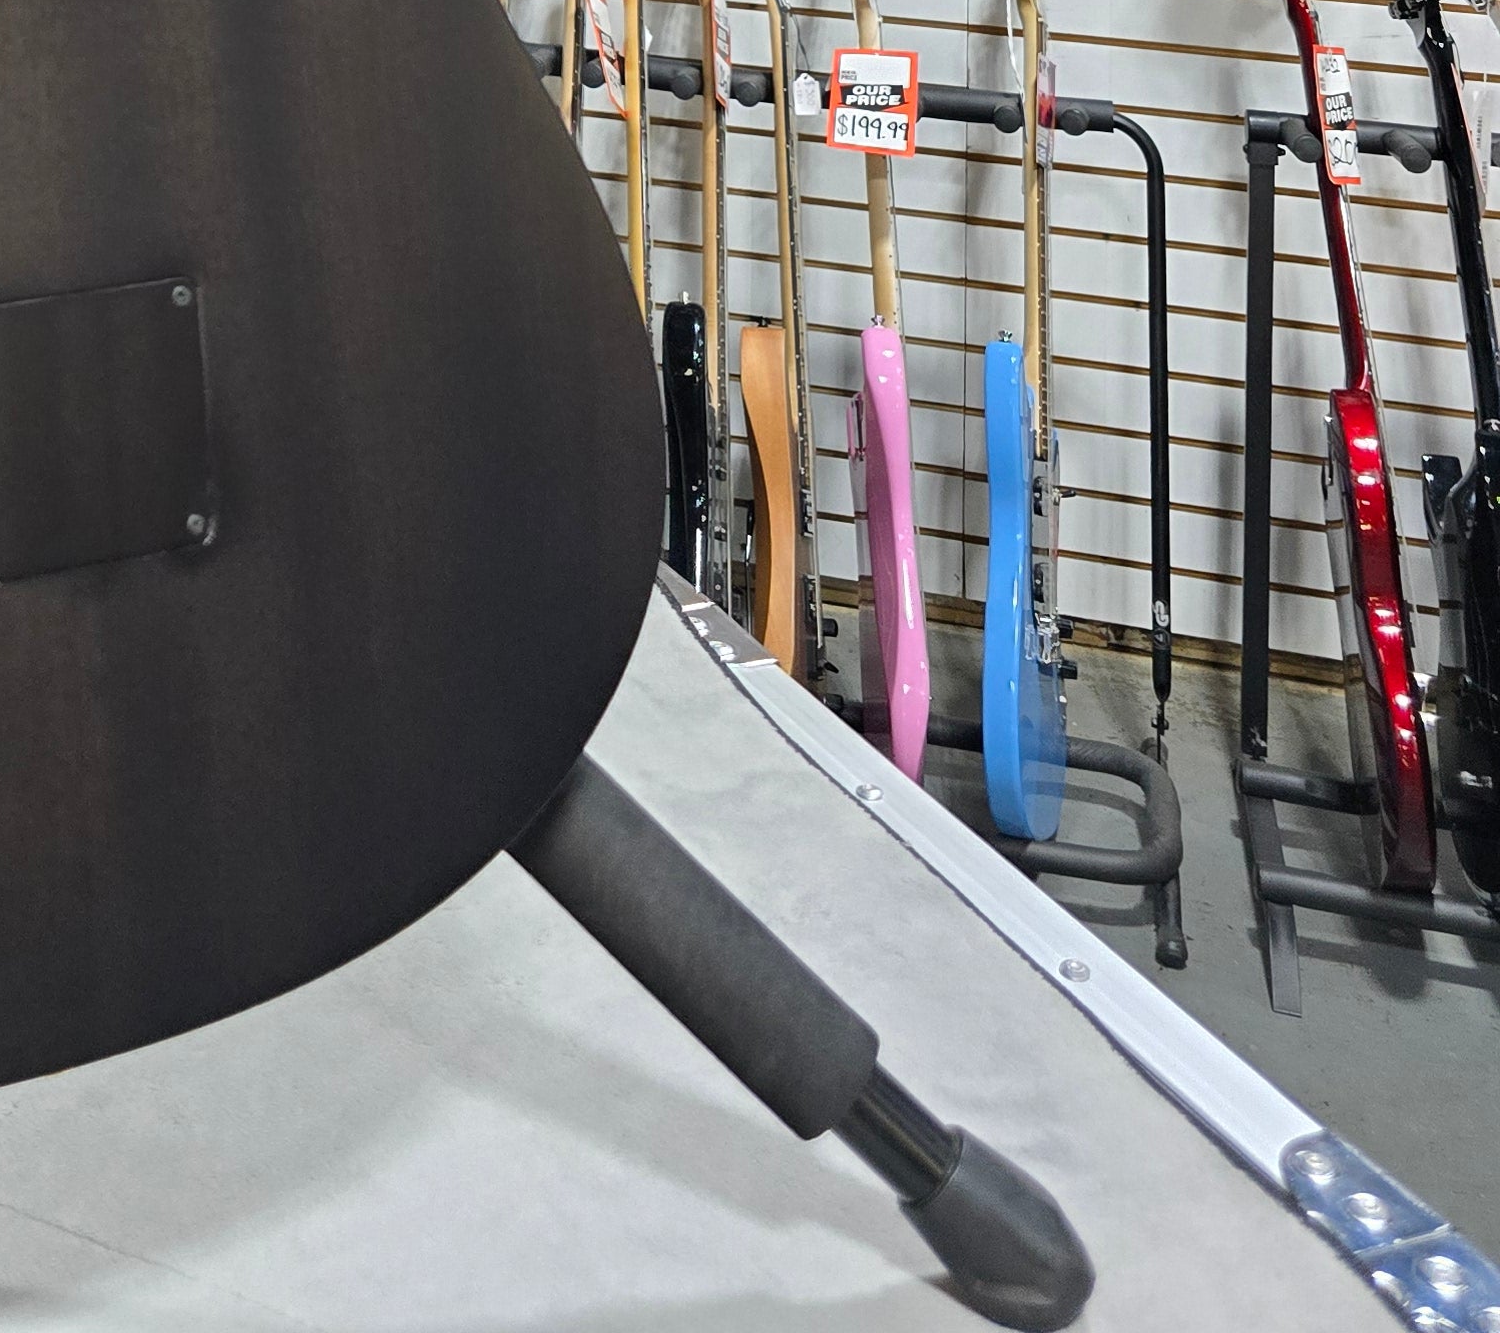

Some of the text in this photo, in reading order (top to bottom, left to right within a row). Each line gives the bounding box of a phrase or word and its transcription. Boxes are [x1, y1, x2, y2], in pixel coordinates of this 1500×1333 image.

[852, 85, 892, 96] OUR
[845, 94, 902, 106] PRICE
[1325, 94, 1348, 111] OUR
[1325, 106, 1354, 127] PRICE
[837, 113, 909, 141] $199.99
